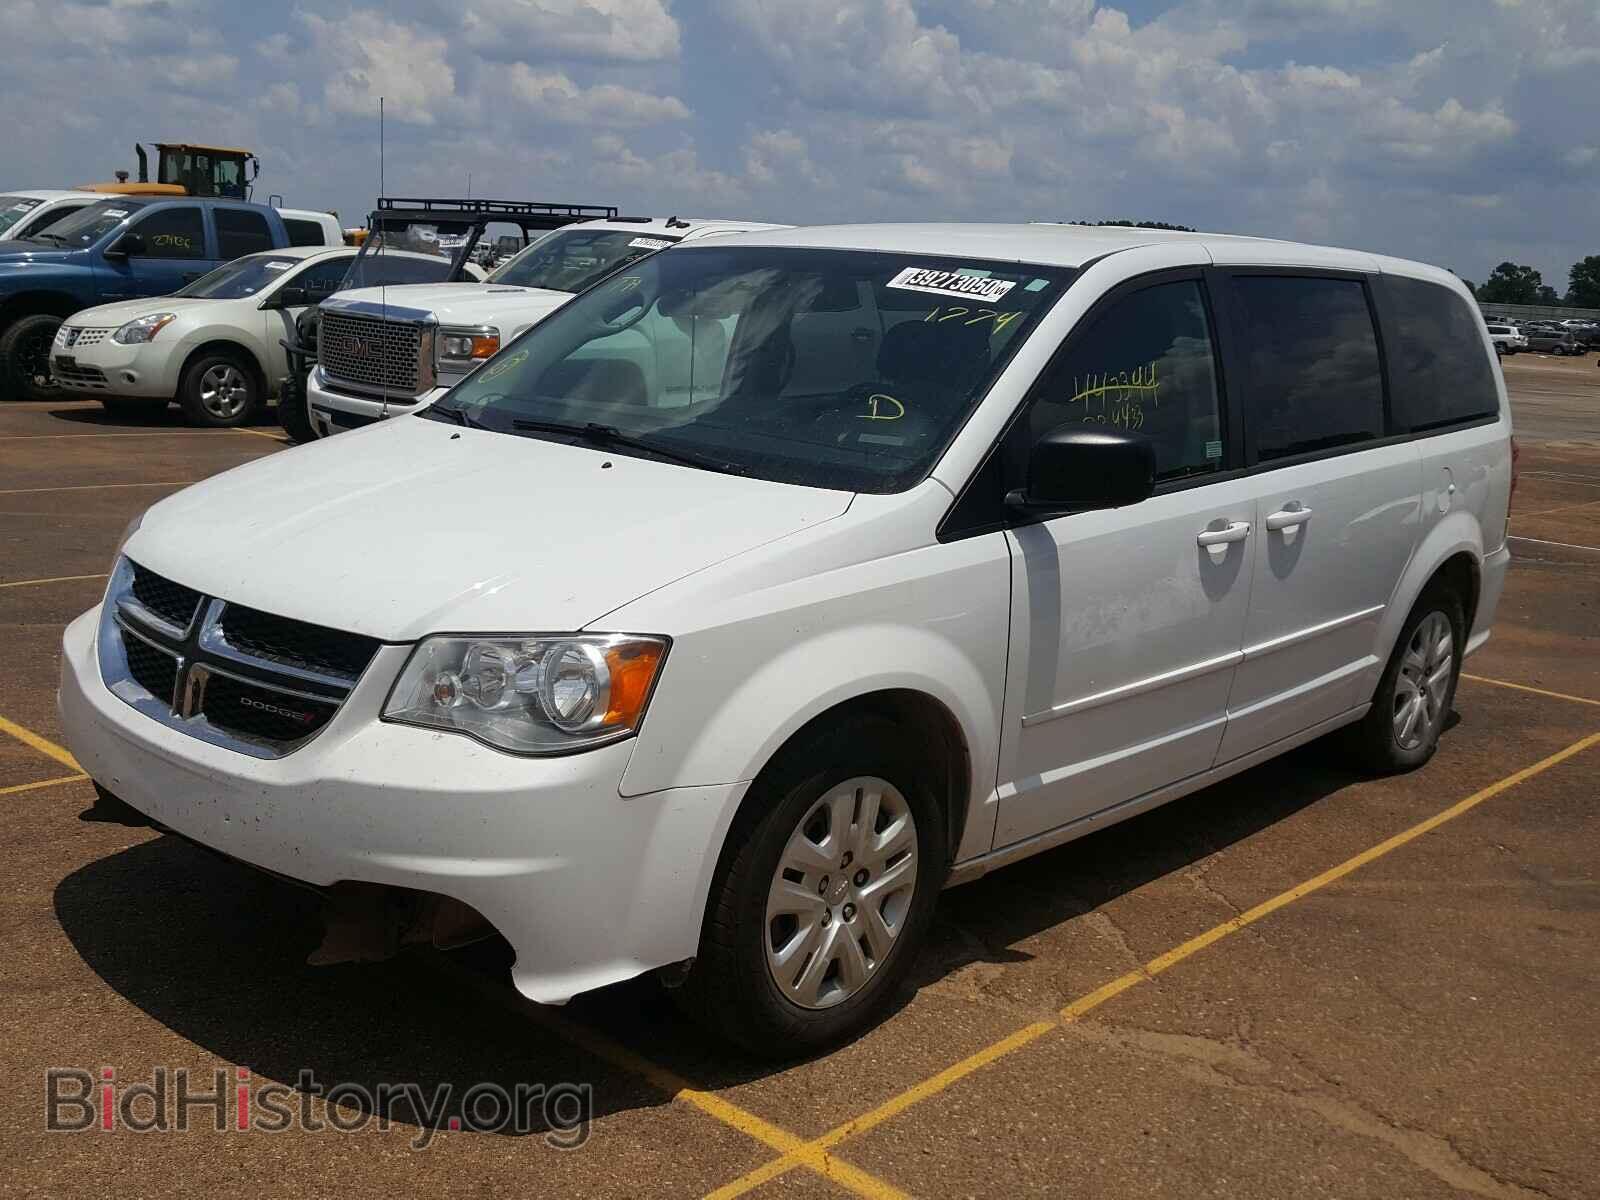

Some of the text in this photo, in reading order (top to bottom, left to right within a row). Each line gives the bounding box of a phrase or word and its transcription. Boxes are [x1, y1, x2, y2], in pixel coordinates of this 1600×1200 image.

[908, 268, 999, 296] 39273050
[342, 336, 384, 358] GMC
[856, 394, 904, 420] D
[240, 697, 305, 720] DODGE
